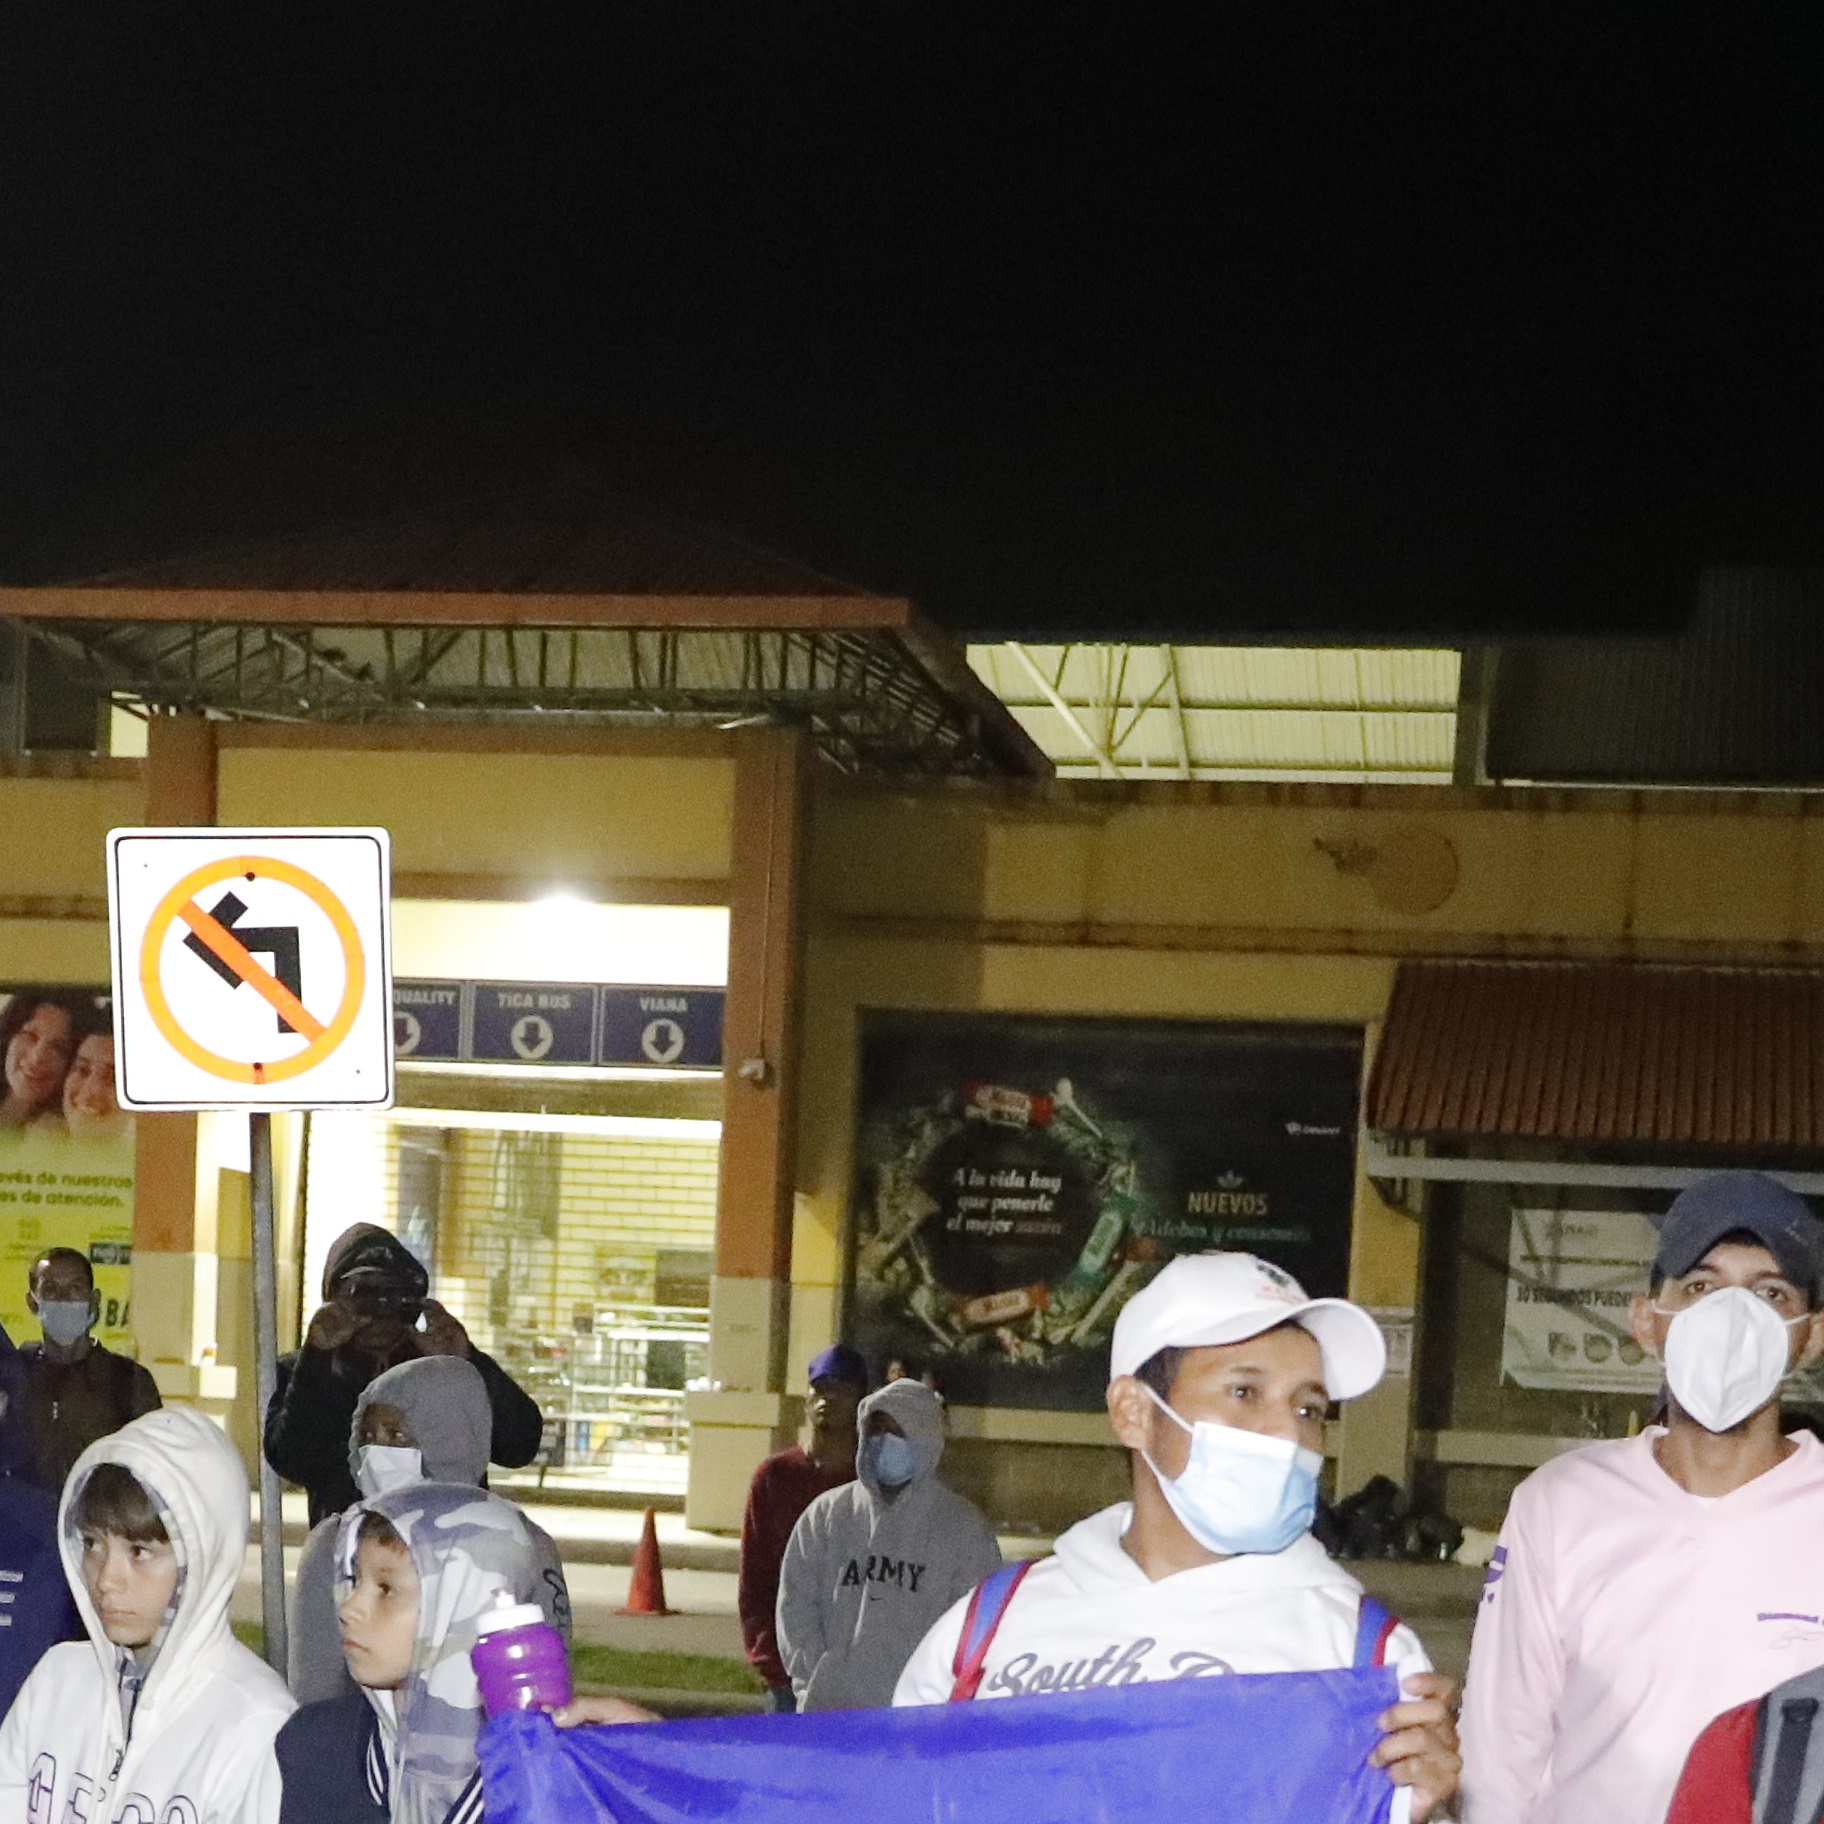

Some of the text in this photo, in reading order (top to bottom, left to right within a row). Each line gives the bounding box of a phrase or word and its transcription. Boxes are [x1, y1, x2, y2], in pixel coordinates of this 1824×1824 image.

[497, 992, 572, 1010] TICA BUS
[37, 1171, 57, 1185] de
[61, 1173, 133, 1189] nuestros
[22, 1189, 42, 1204] de
[1187, 1190, 1269, 1216] NUEVOS
[841, 1555, 926, 1593] ARMY
[986, 1636, 1157, 1697] South
